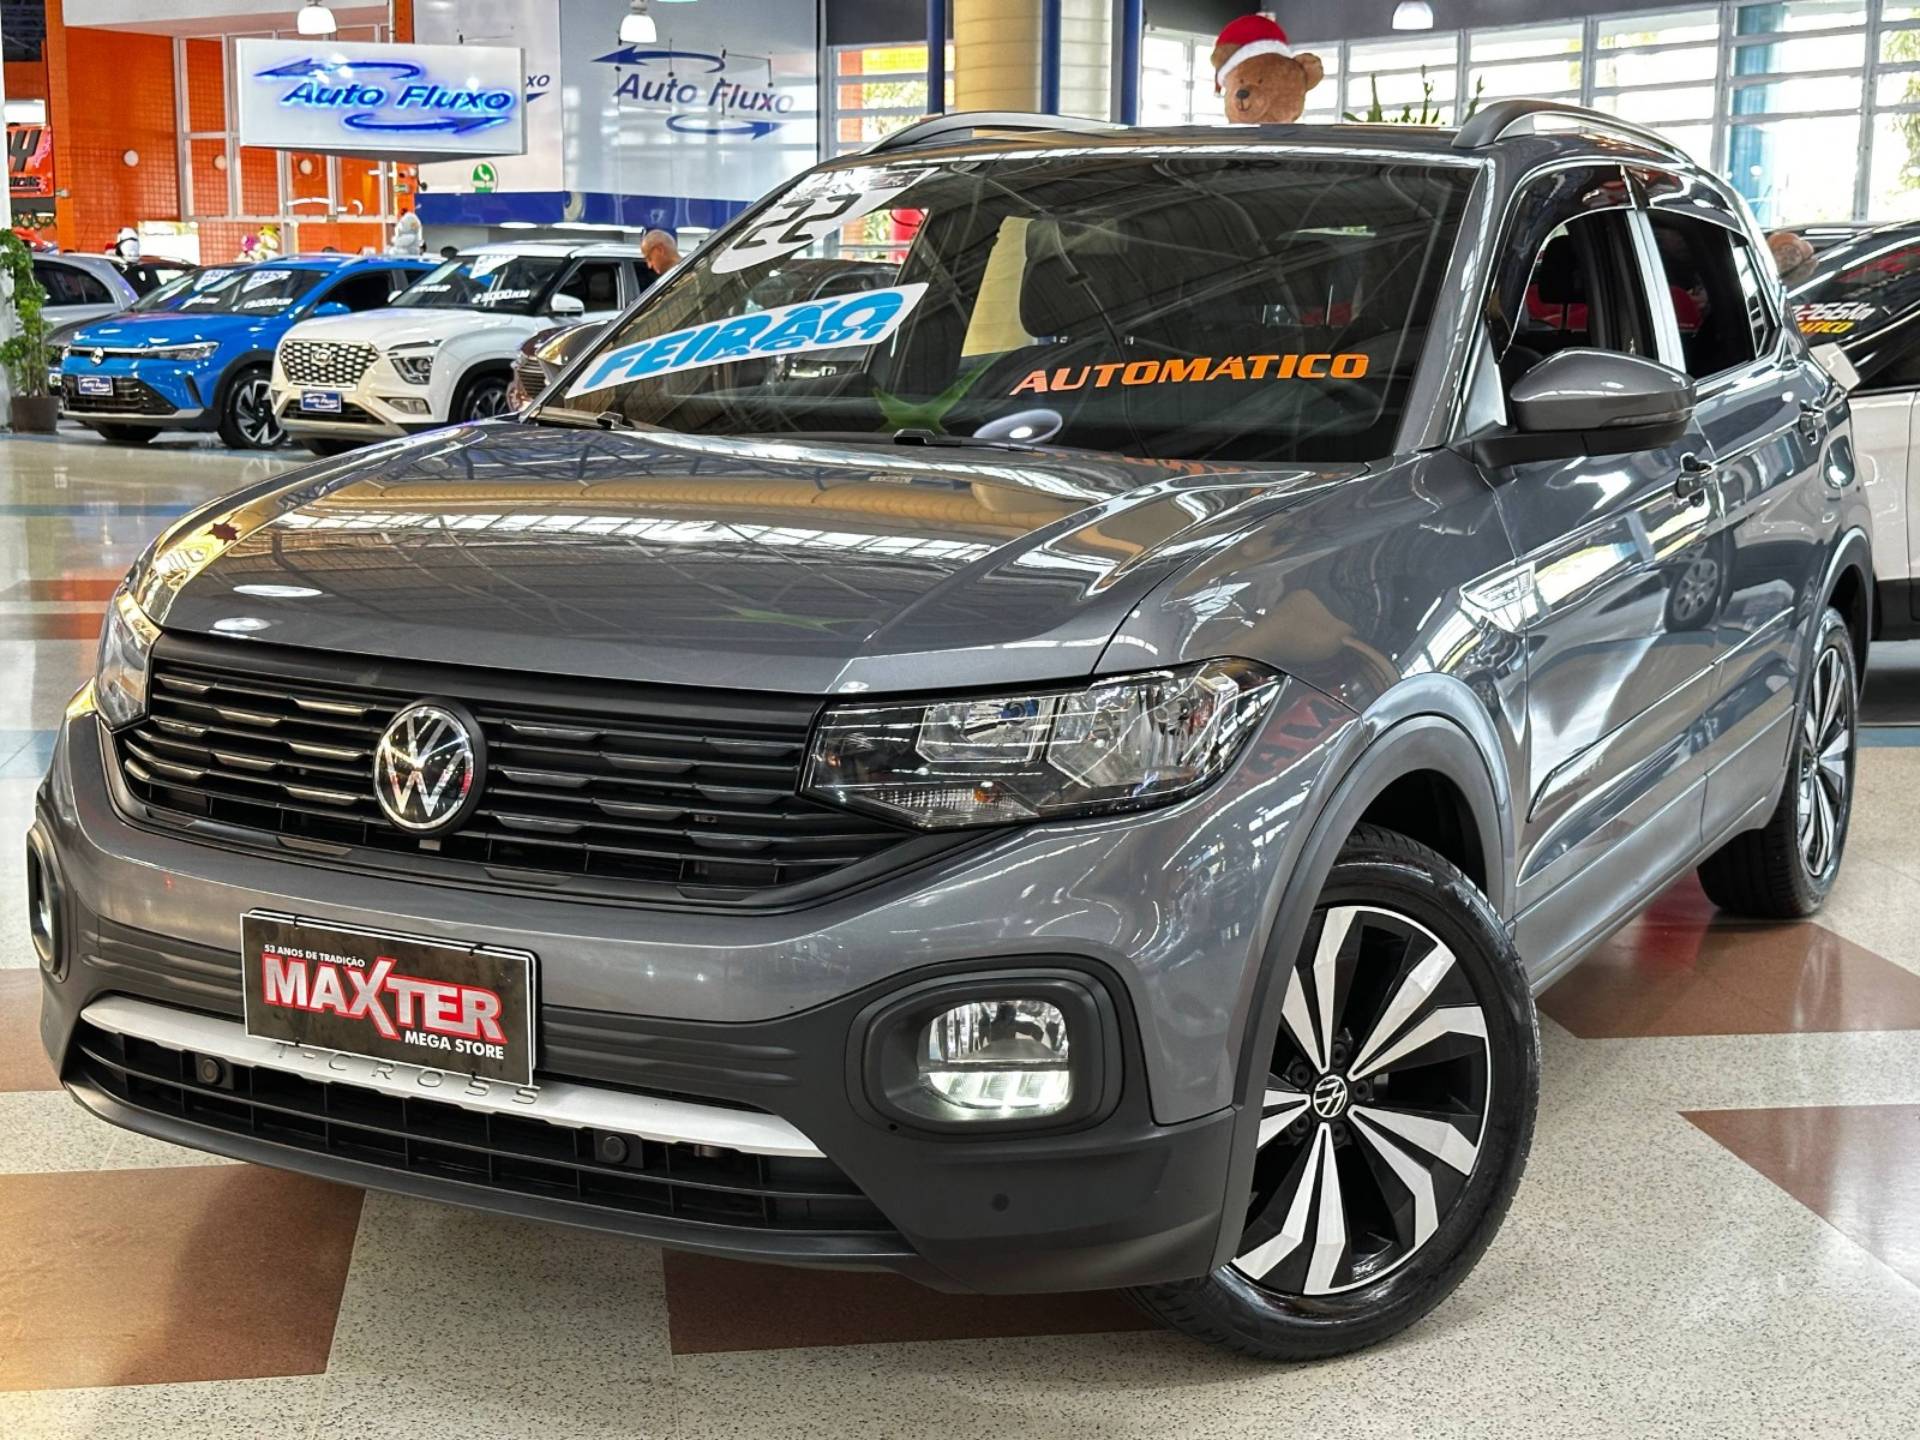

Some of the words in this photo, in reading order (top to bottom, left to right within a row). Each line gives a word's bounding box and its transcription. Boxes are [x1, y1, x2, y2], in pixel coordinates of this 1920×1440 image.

[281, 82, 384, 106] Auto
[396, 84, 512, 111] Fluxo
[613, 73, 698, 104] Auto
[708, 80, 795, 114] Fluxo
[1009, 353, 1369, 396] AUTOMÁTICO
[264, 944, 276, 954] 53
[275, 945, 304, 959] ANOS
[305, 949, 319, 961] DE
[319, 952, 366, 969] TRADIÇÃO
[261, 953, 509, 1045] MAXTER
[404, 1029, 452, 1051] MEGA
[455, 1041, 505, 1060] STORE
